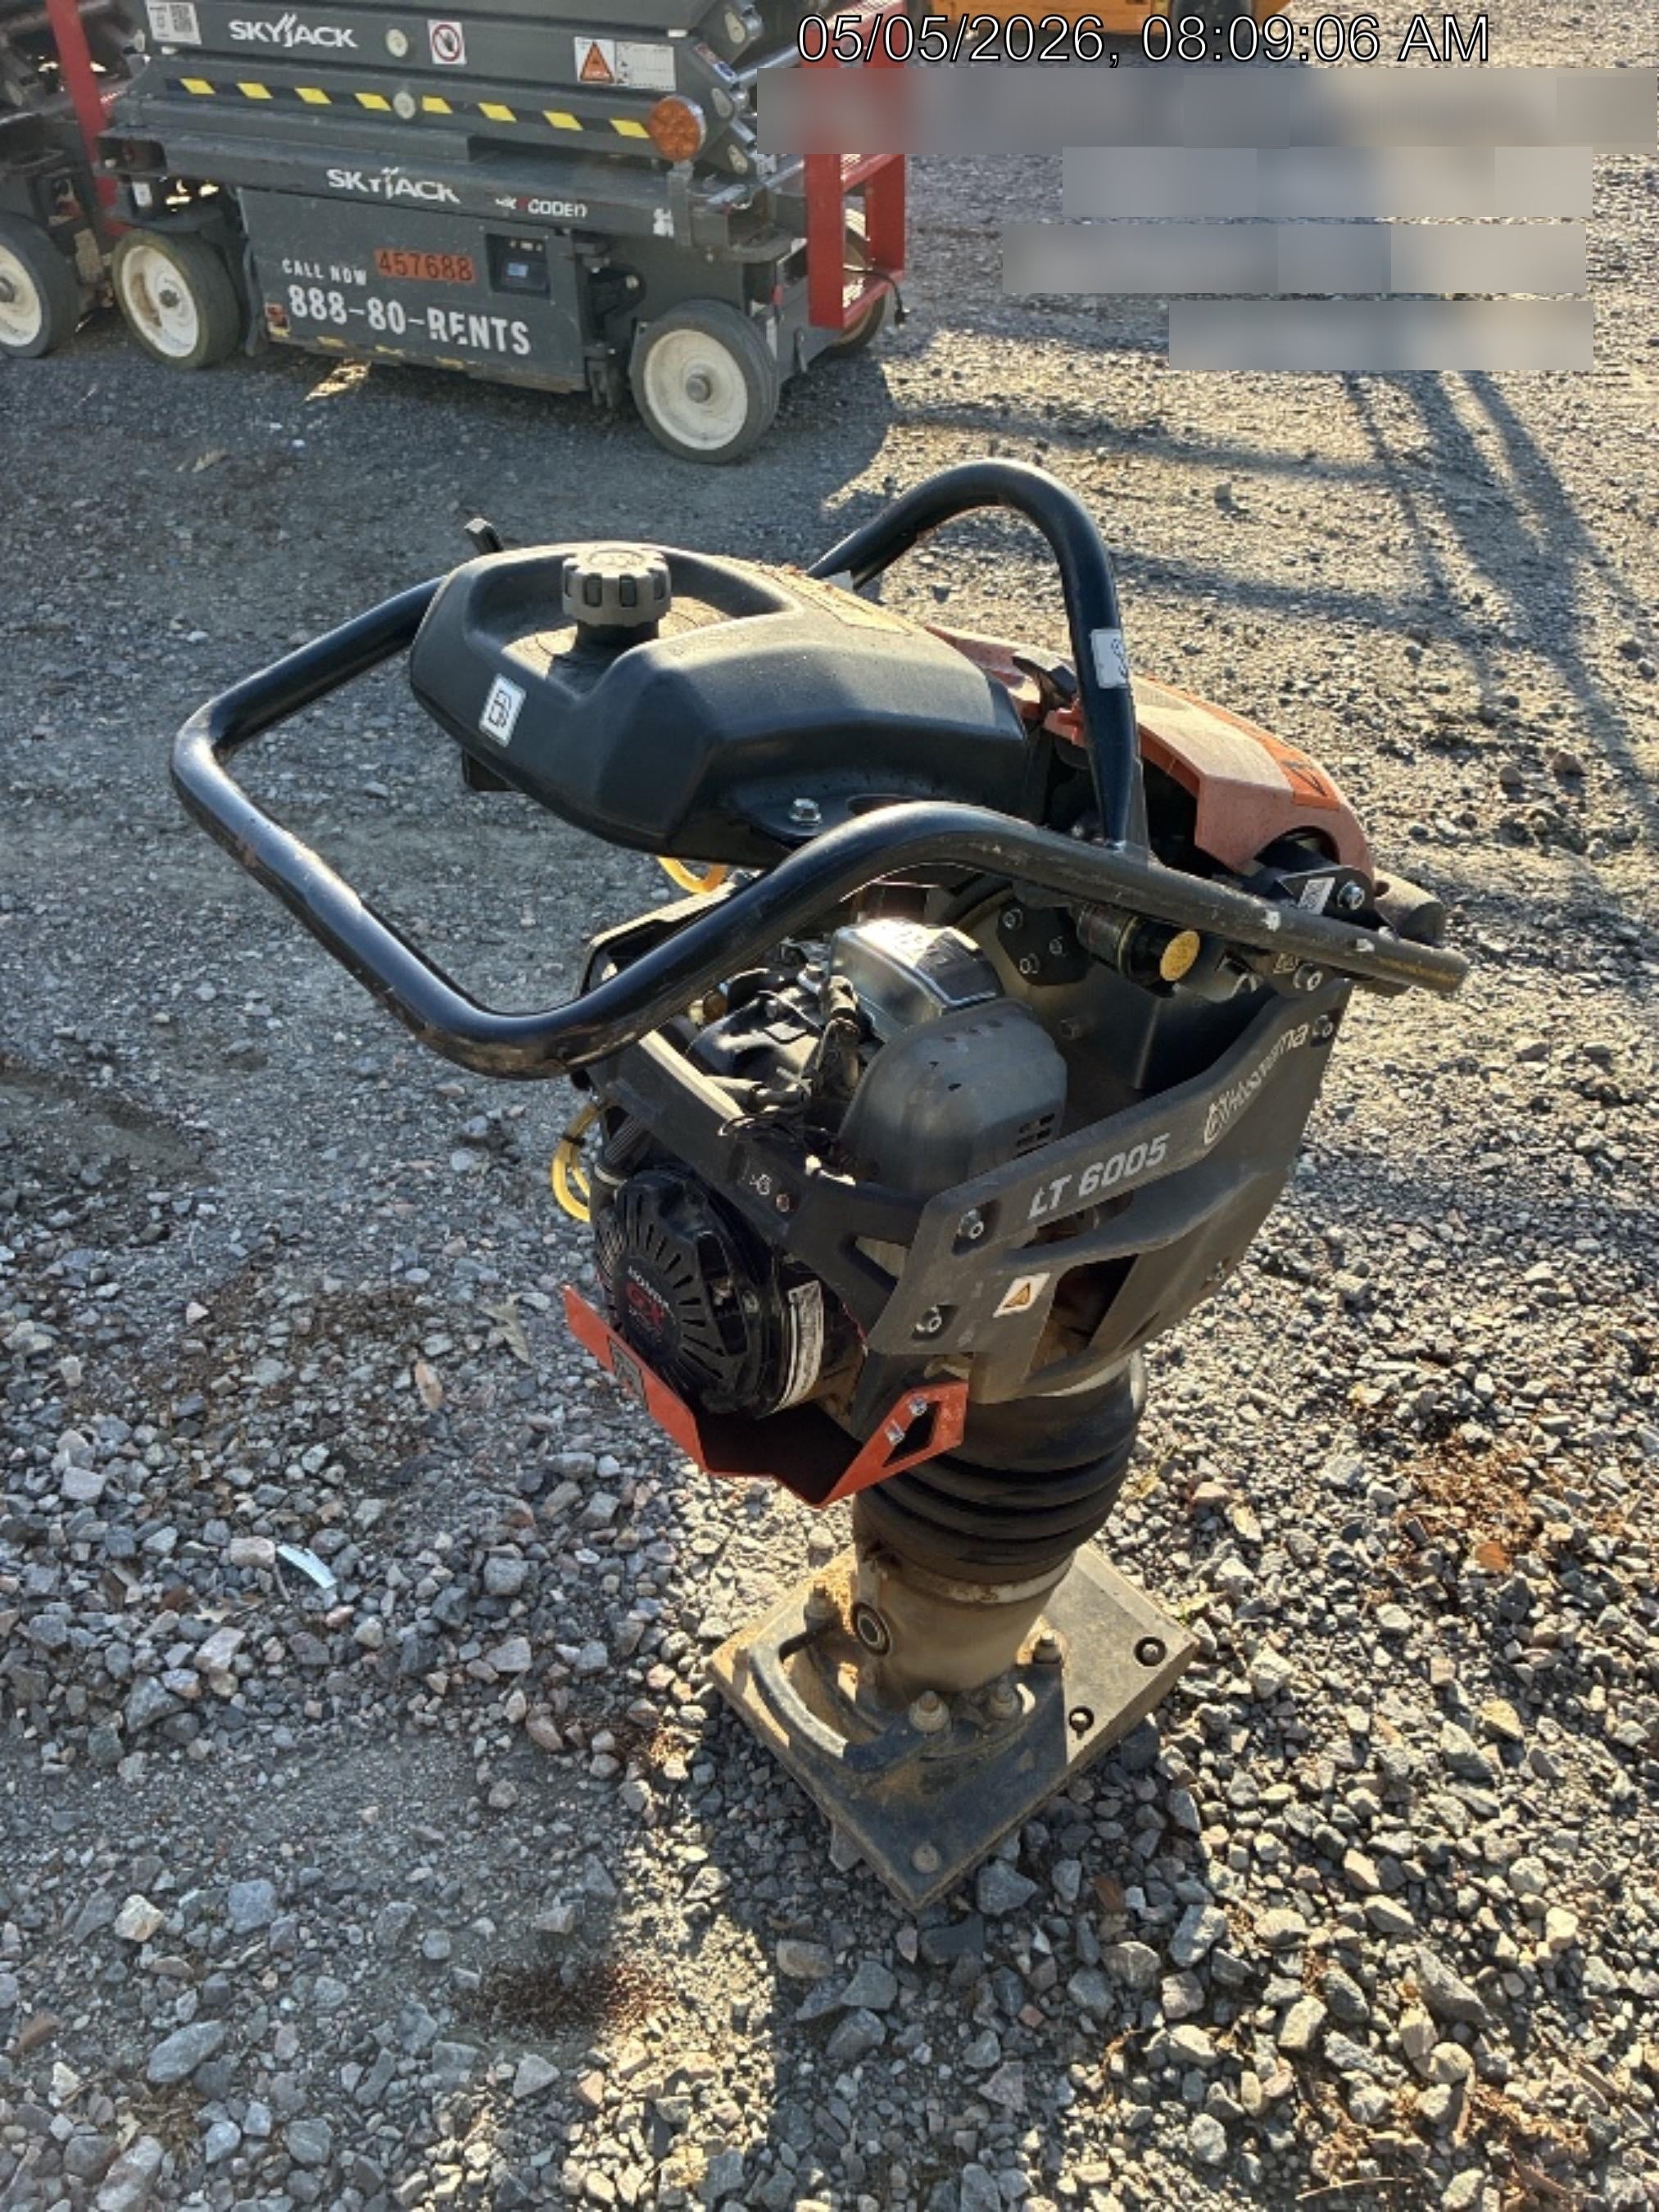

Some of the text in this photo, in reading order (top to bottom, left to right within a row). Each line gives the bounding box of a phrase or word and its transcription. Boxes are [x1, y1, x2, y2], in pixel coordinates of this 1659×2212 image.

[228, 12, 359, 48] SKYJACK
[326, 167, 461, 204] SKYJACK
[282, 257, 367, 286] CALL NOW
[377, 251, 474, 281] 457688
[288, 284, 531, 355] 888-80-RENTS
[1027, 1132, 1171, 1219] LT 6005
